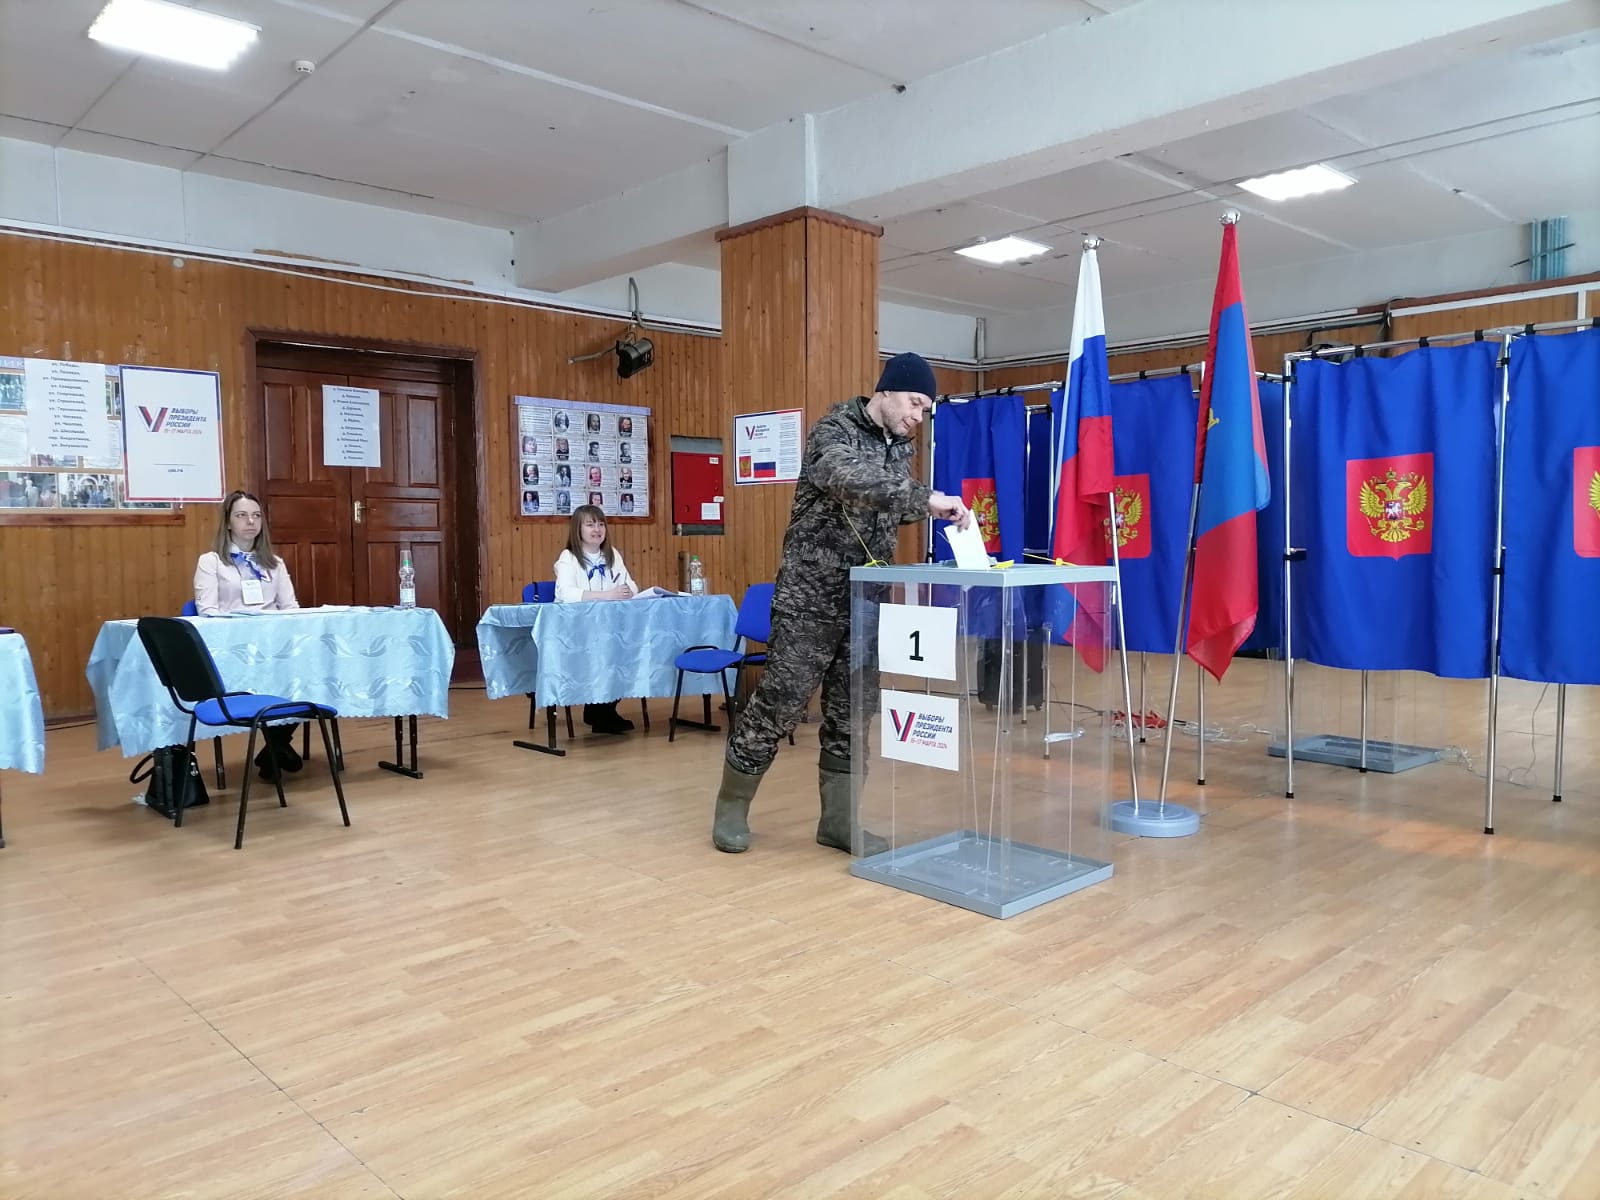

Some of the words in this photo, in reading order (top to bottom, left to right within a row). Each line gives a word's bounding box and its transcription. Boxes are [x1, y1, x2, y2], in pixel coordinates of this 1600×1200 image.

[171, 407, 199, 415] ВЫБОРЫ
[168, 414, 207, 422] ПРЕЗИДЕНТА
[909, 630, 924, 662] 1
[918, 713, 945, 723] ВЫБОРЫ
[915, 721, 953, 734] ПРЕЗИДЕНТА
[912, 729, 936, 739] РОССИИ
